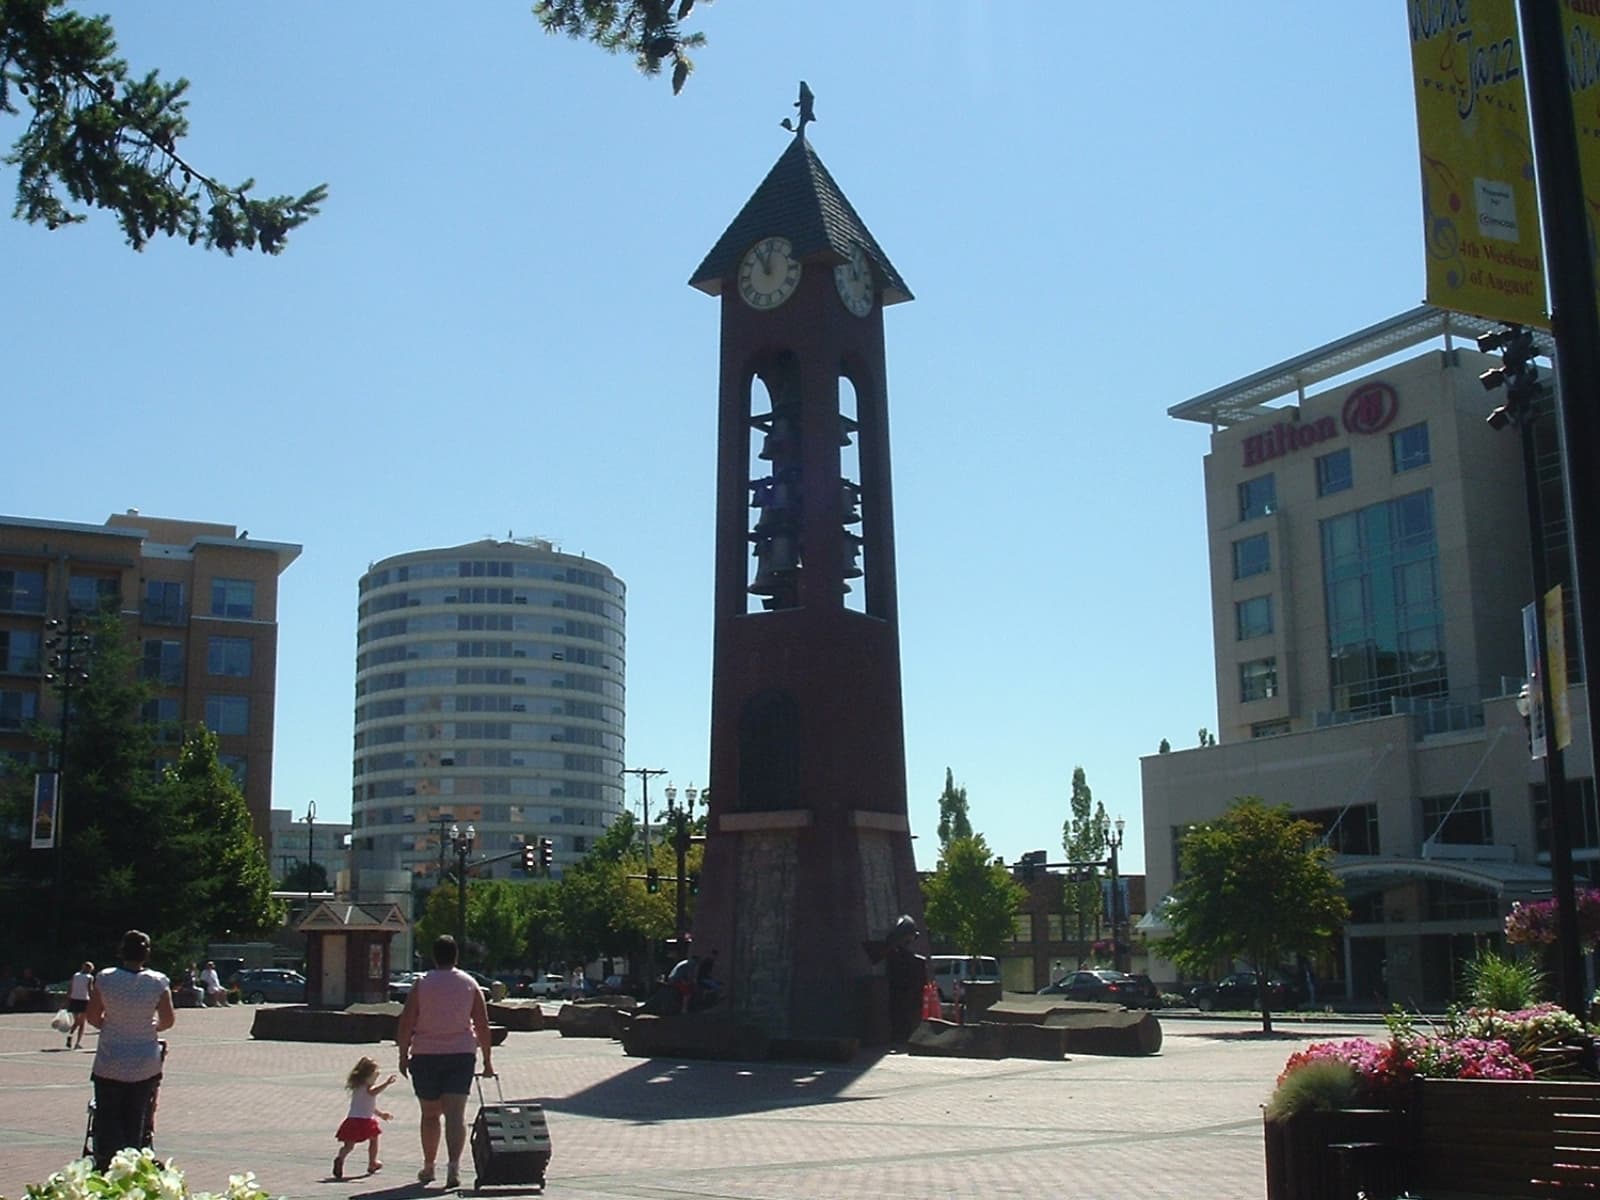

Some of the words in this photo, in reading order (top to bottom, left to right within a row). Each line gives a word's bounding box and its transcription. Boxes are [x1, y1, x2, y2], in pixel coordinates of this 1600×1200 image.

[1456, 30, 1519, 119] Jazz
[1459, 240, 1480, 258] 4th
[1483, 244, 1540, 272] Weekend
[1470, 269, 1483, 284] of
[1242, 416, 1339, 468] Hilton
